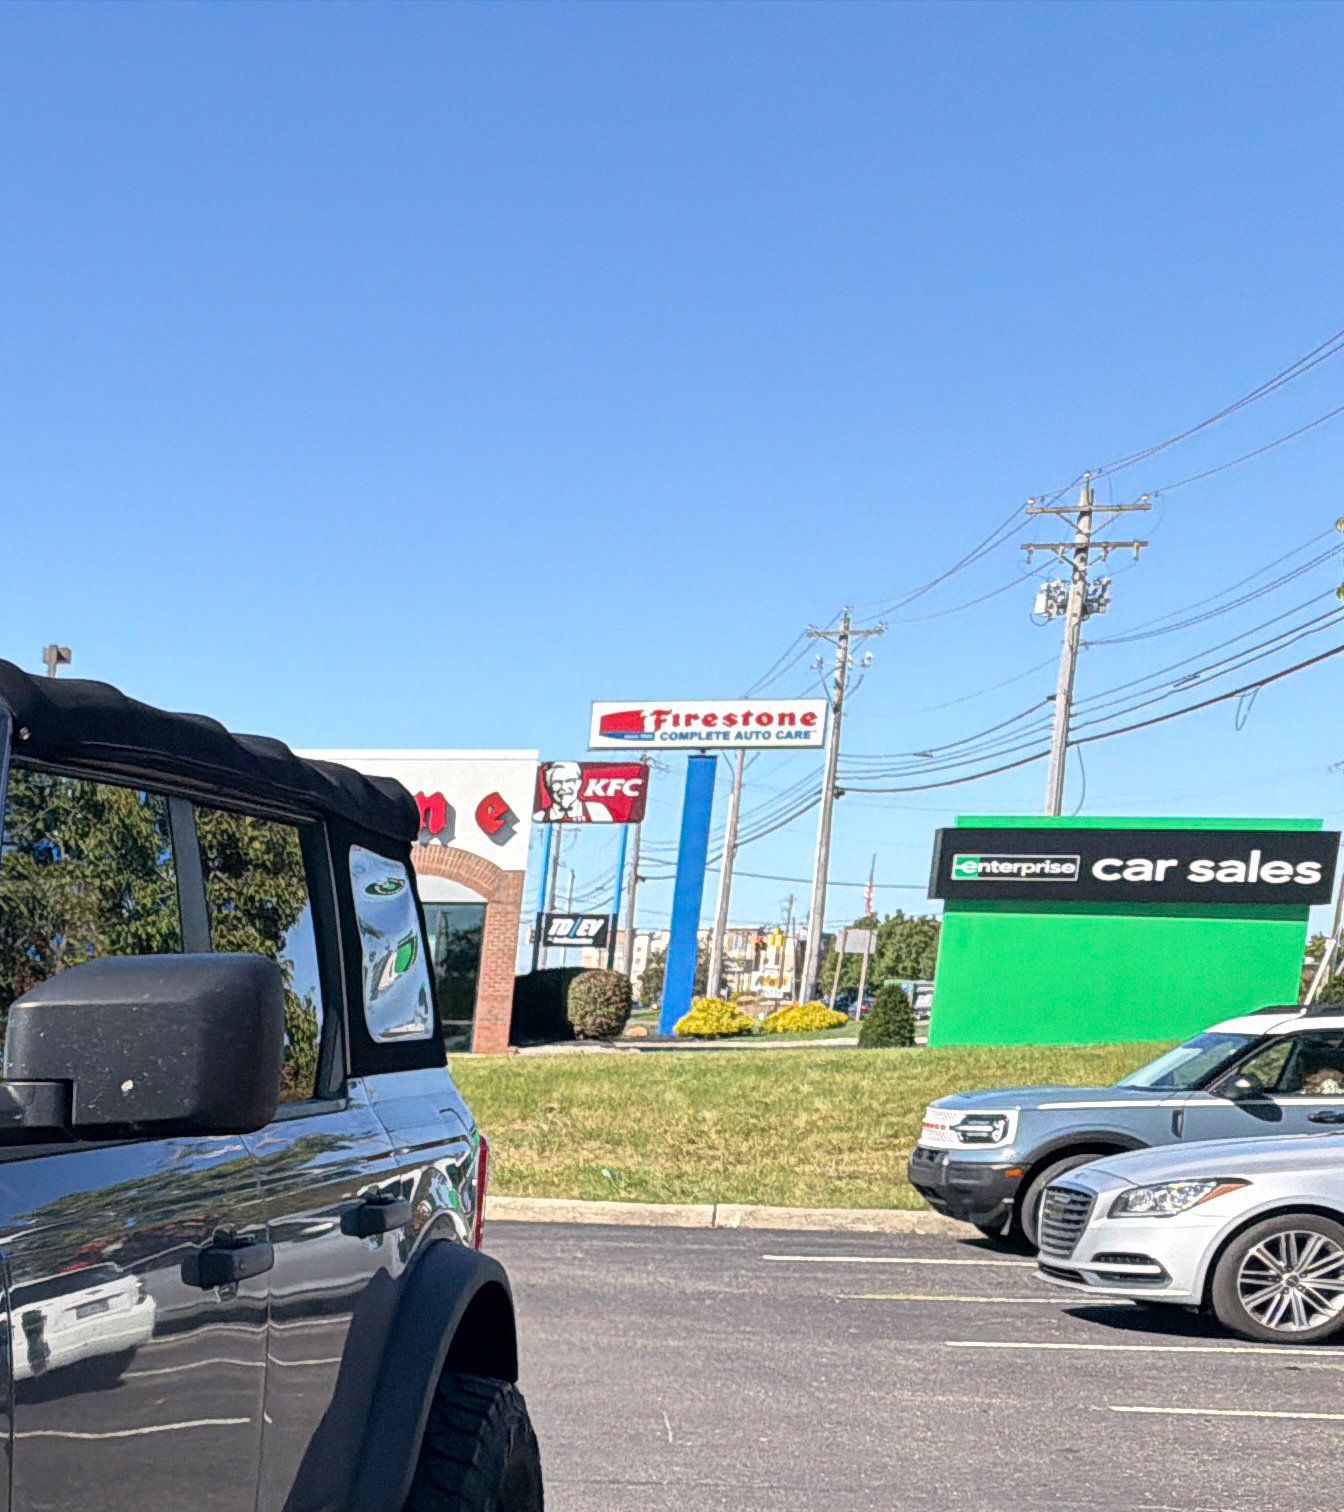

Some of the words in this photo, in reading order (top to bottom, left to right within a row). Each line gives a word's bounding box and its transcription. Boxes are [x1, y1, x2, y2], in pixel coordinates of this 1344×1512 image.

[652, 709, 818, 733] Firestone
[660, 730, 731, 741] COMPLETE
[734, 730, 772, 741] AUTO
[775, 729, 812, 741] CARE
[583, 778, 644, 798] KFC
[955, 857, 1077, 876] enterprise
[1091, 856, 1179, 883] car
[1186, 849, 1323, 885] sales
